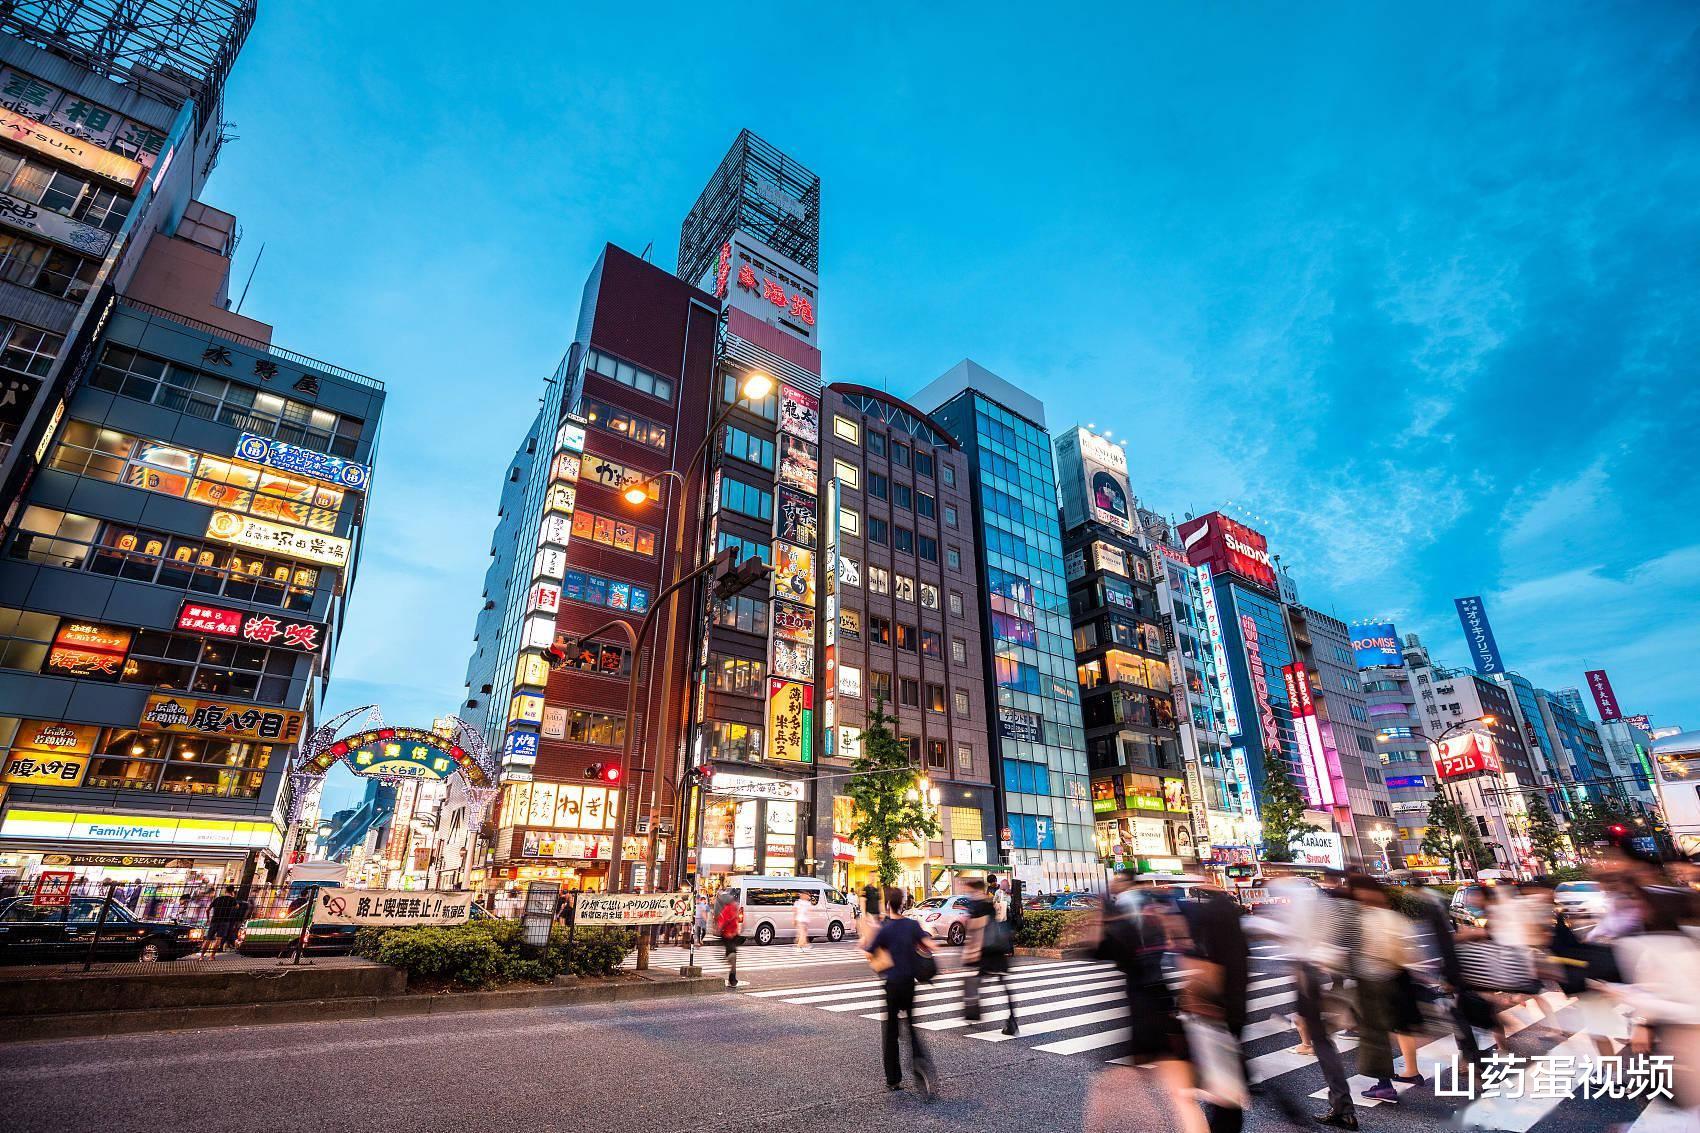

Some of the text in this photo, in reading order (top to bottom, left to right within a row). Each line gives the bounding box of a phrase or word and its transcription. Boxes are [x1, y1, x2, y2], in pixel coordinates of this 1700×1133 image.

[1225, 533, 1272, 568] SHIDAX
[244, 616, 319, 650] 海峡
[1466, 611, 1495, 671] オザキクリニック
[189, 706, 284, 738] 腹八分目
[356, 743, 450, 771] 歌舞伎町
[1443, 757, 1476, 774] アコム
[7, 759, 80, 780] 腹八分目
[380, 764, 425, 776] さくら通り
[557, 795, 618, 819] ねぎし
[88, 825, 161, 838] FamilyMart
[1301, 839, 1333, 848] KARAOKE
[73, 856, 122, 865] おいしくなった。
[1306, 854, 1331, 864] SHIDAX
[356, 897, 466, 918] 路上喫煙禁止!! 新宿区
[580, 899, 668, 910] 分煙で思いやりの街に。
[581, 911, 623, 919] 新宿区内全域
